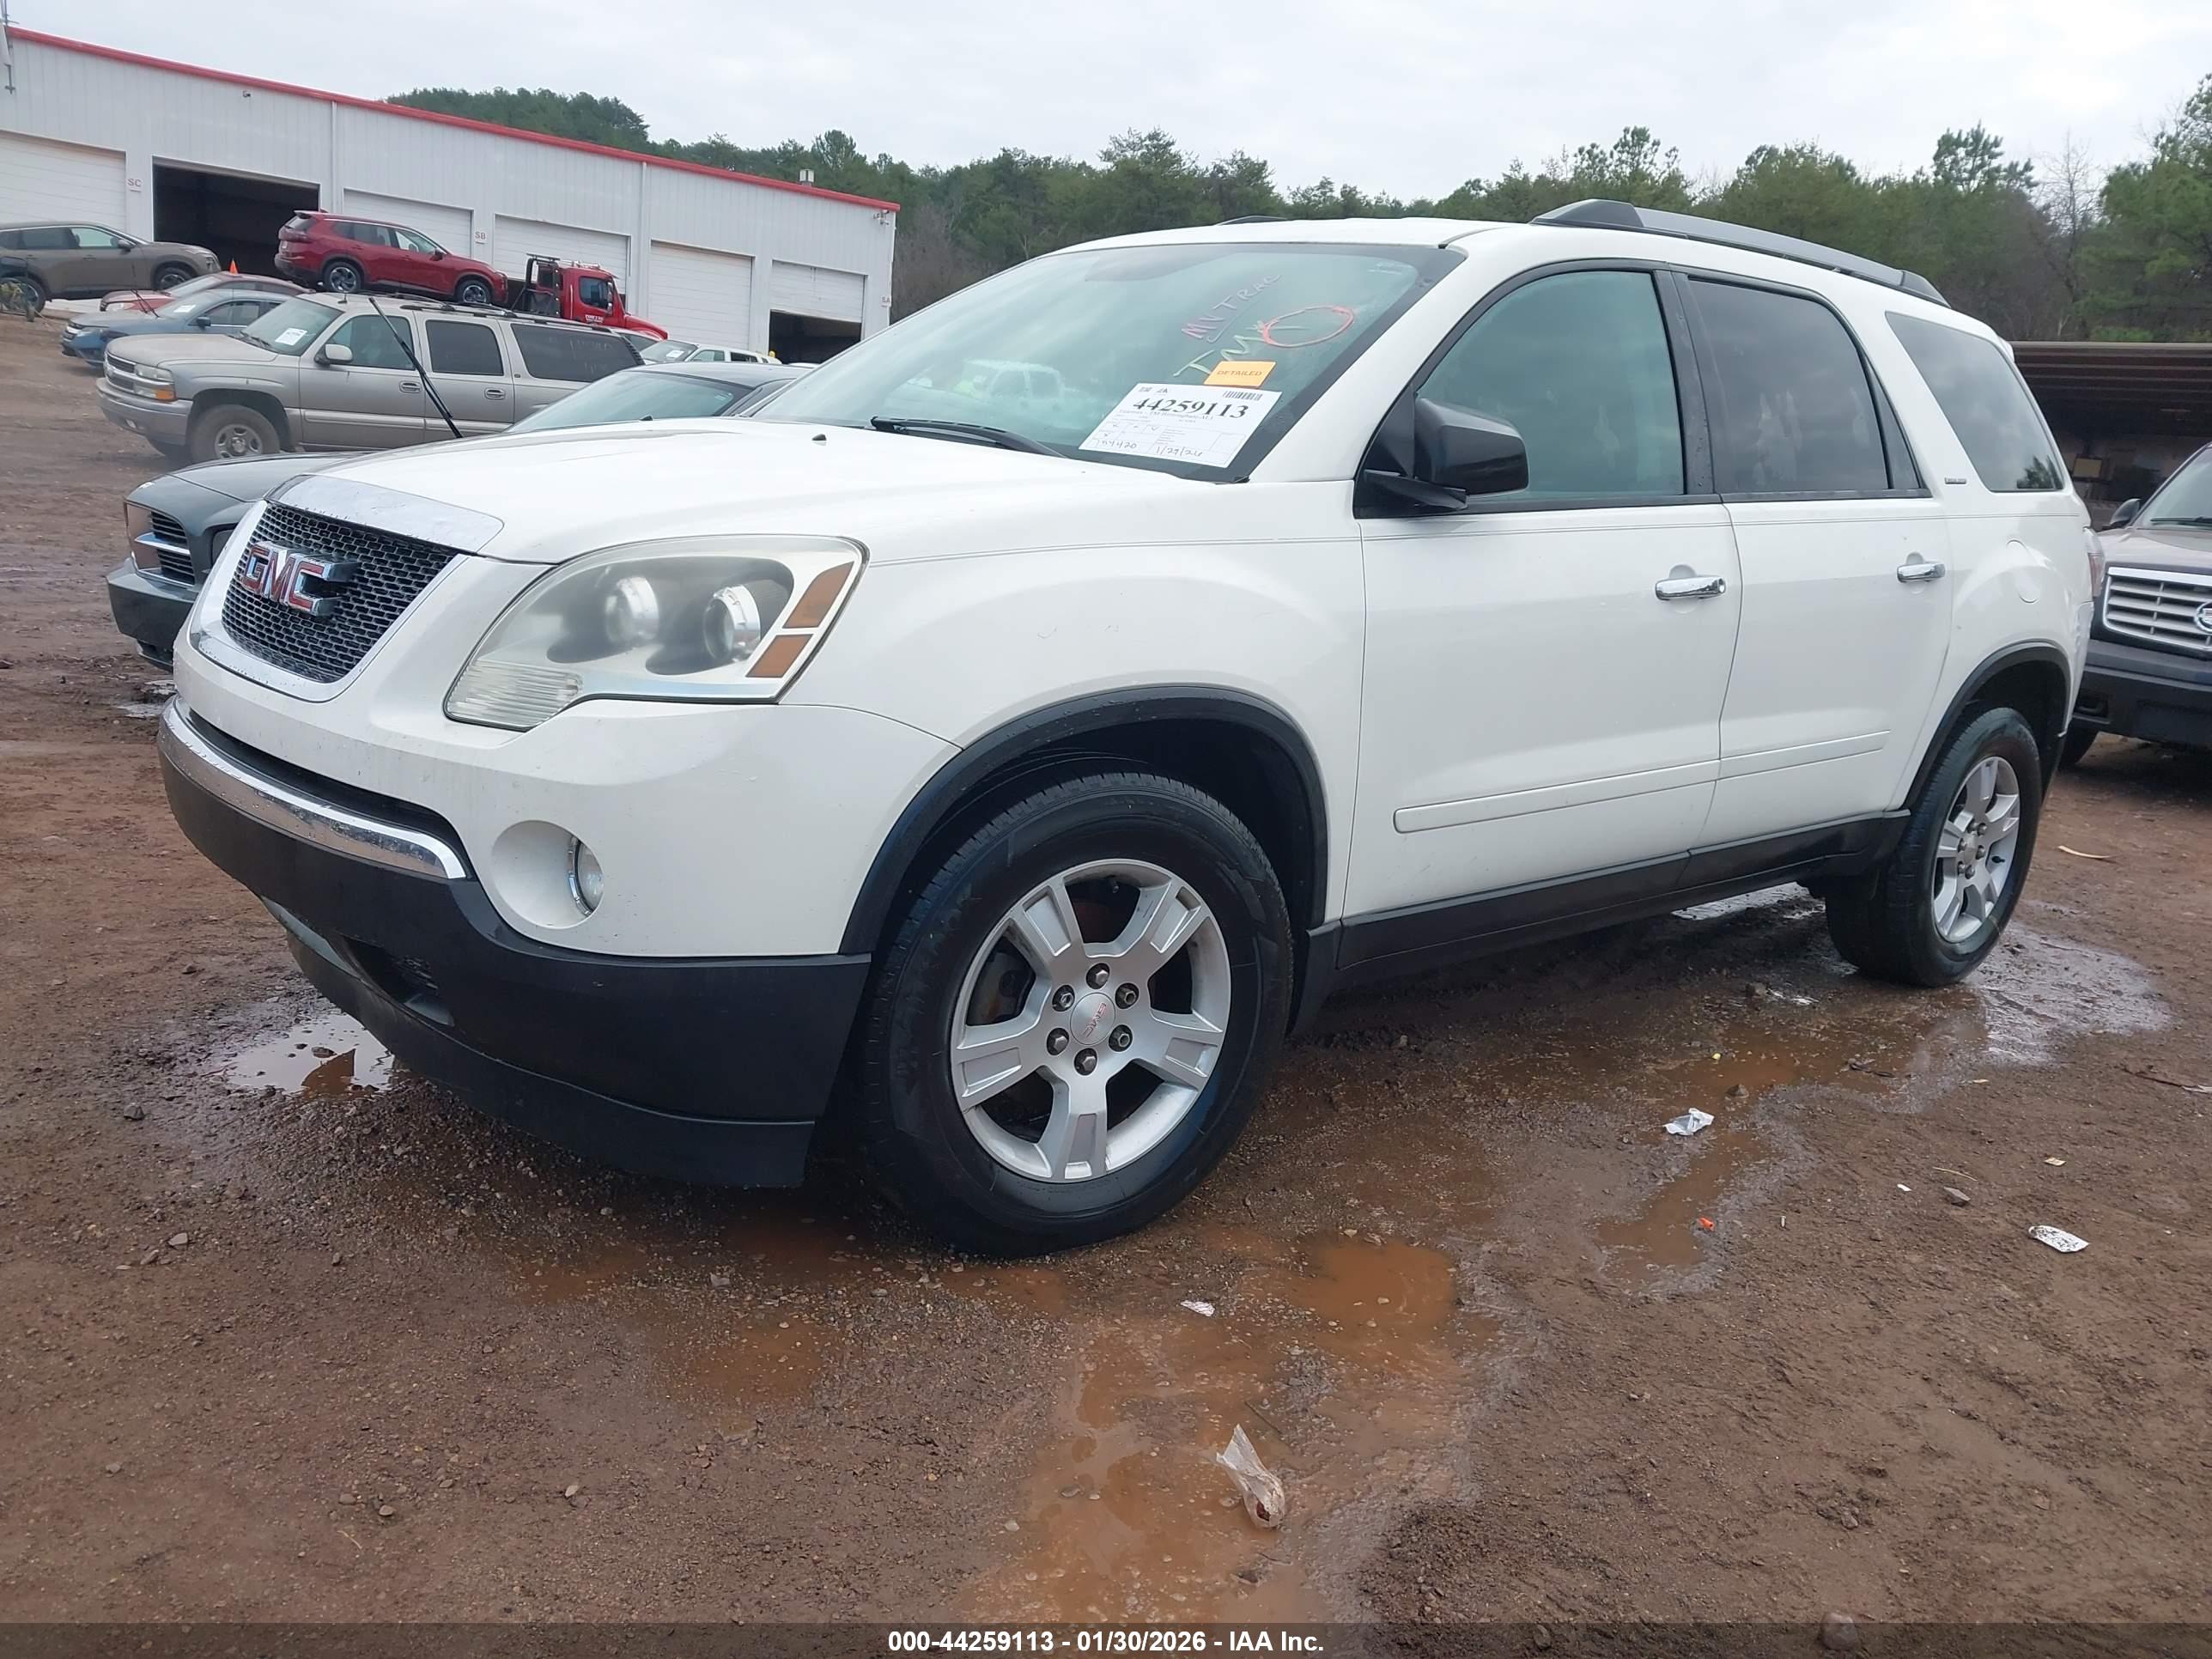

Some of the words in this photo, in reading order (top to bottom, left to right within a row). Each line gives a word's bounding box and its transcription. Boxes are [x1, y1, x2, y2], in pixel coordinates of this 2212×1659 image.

[127, 178, 142, 186] SC
[1133, 398, 1249, 419] 44259113
[241, 542, 334, 616] GMC
[1083, 1002, 1107, 1037] GMC
